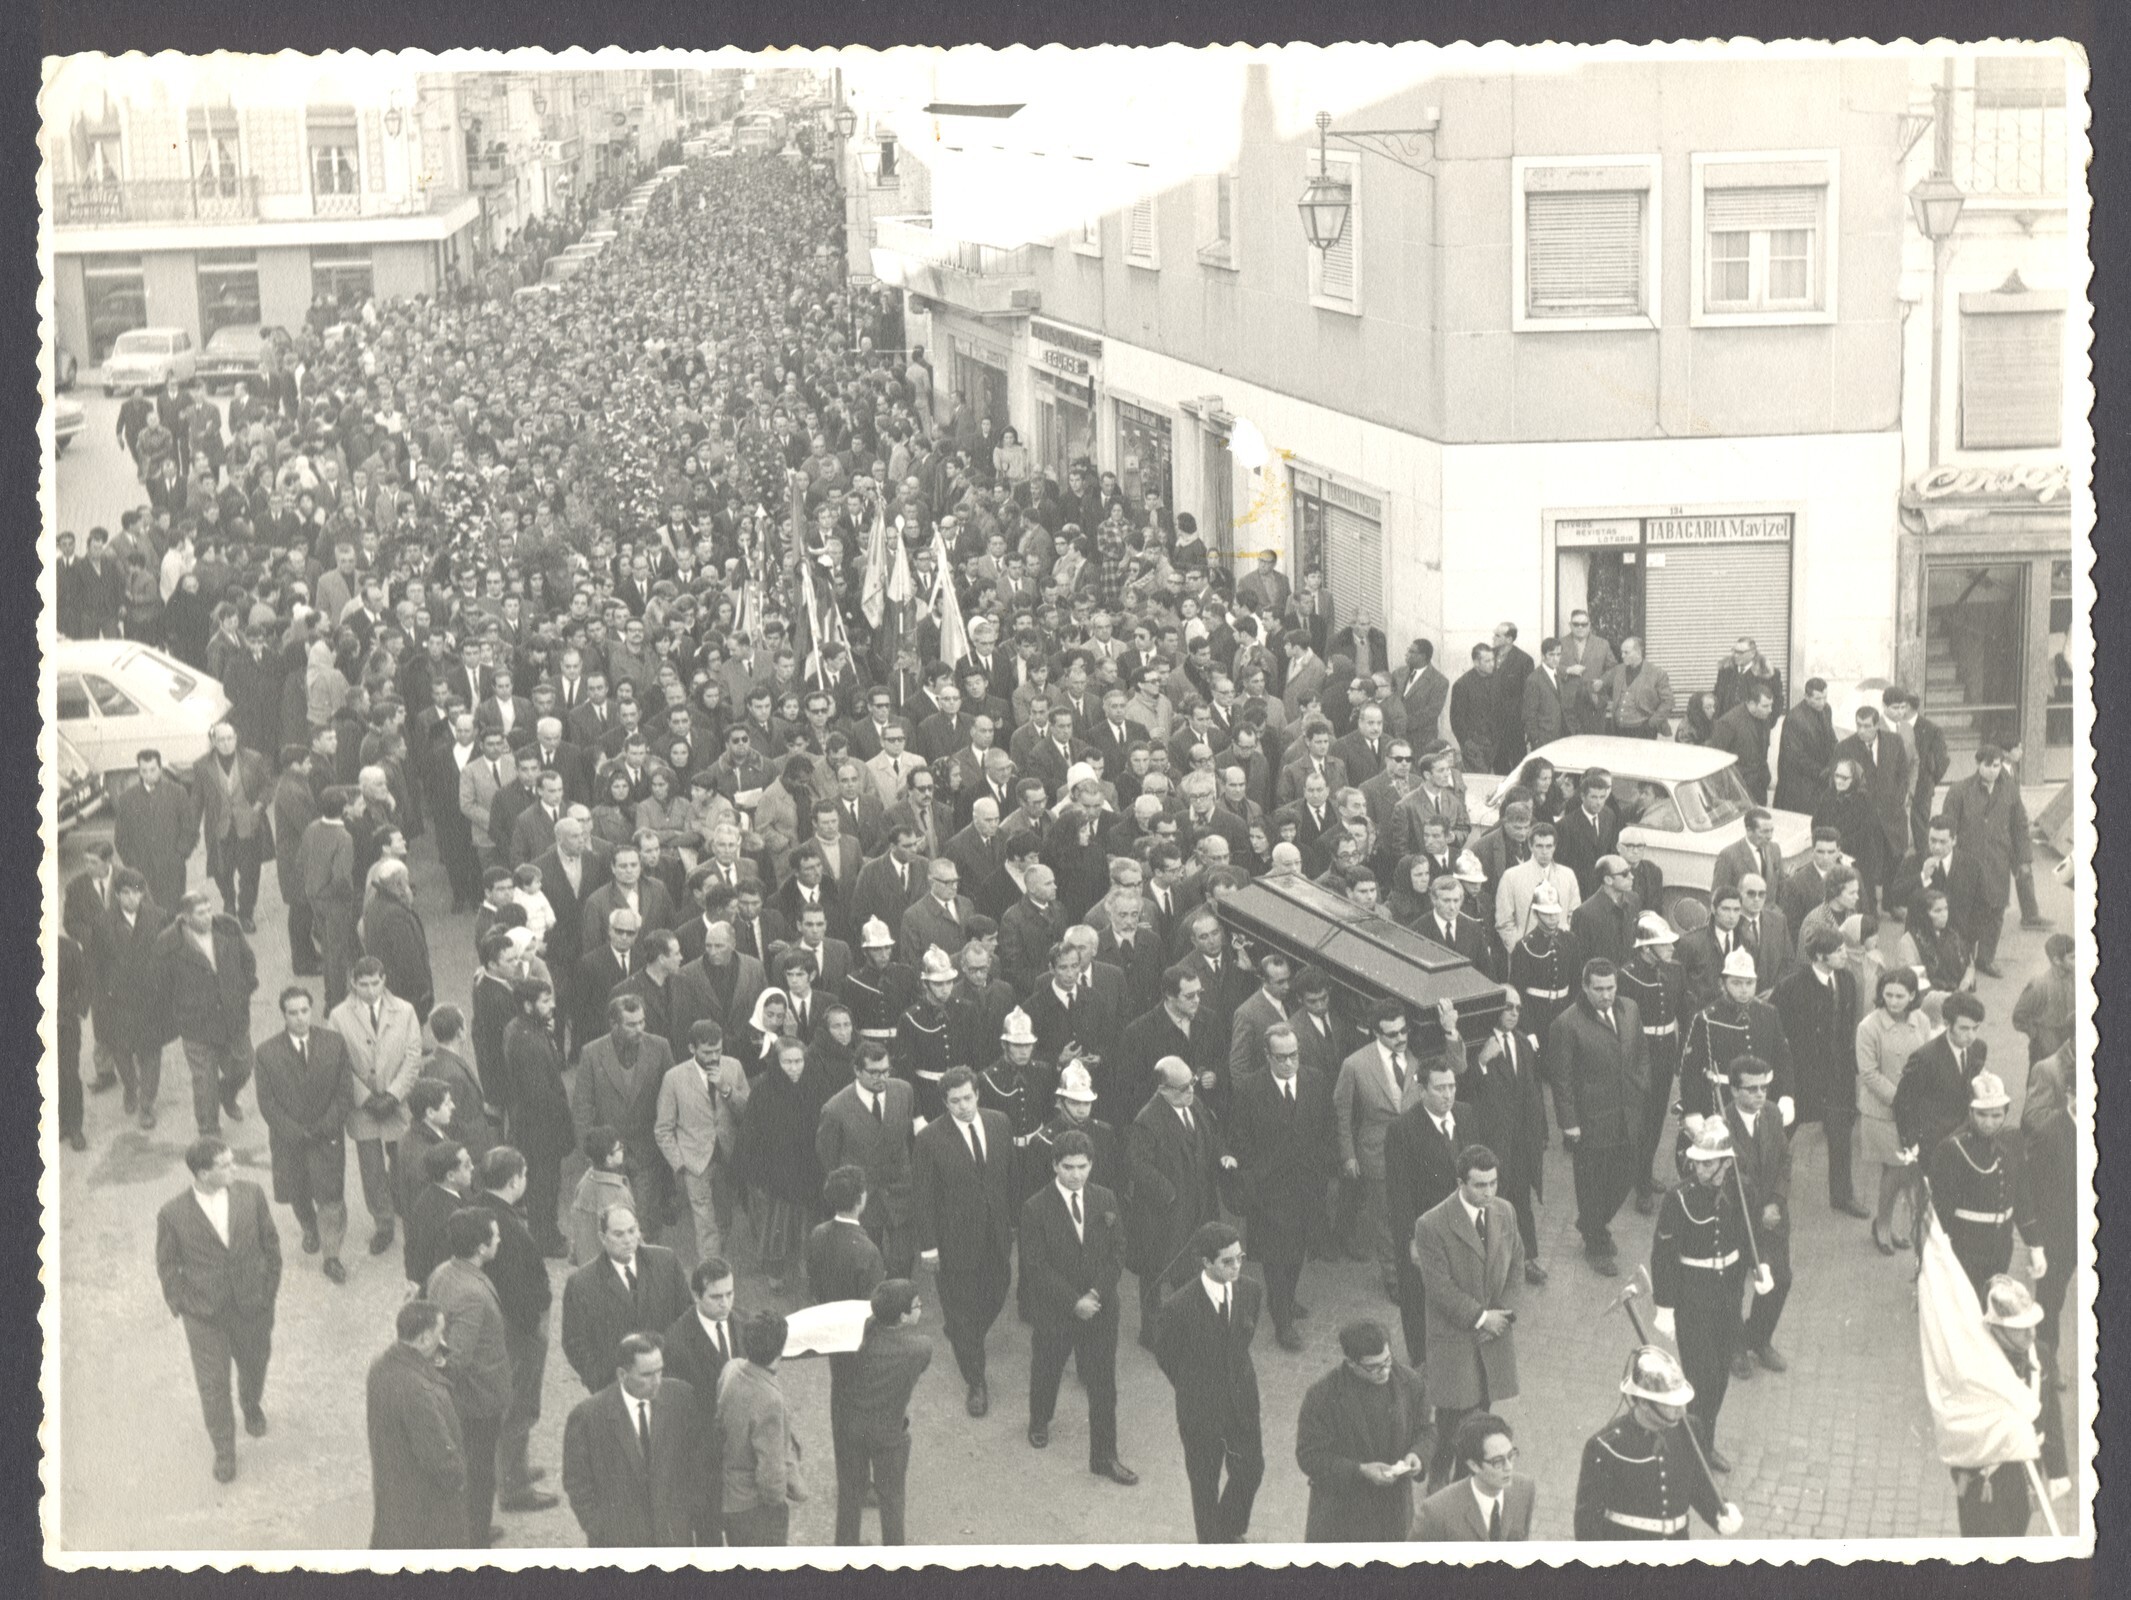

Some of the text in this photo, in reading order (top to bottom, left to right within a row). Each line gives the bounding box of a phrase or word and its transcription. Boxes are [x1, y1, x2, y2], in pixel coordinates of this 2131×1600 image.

[1561, 521, 1592, 529] LIVROS
[1649, 518, 1787, 540] TABACARIA Mavizel
[1576, 528, 1617, 536] REVISTAS
[1597, 536, 1634, 544] LOTARIA
